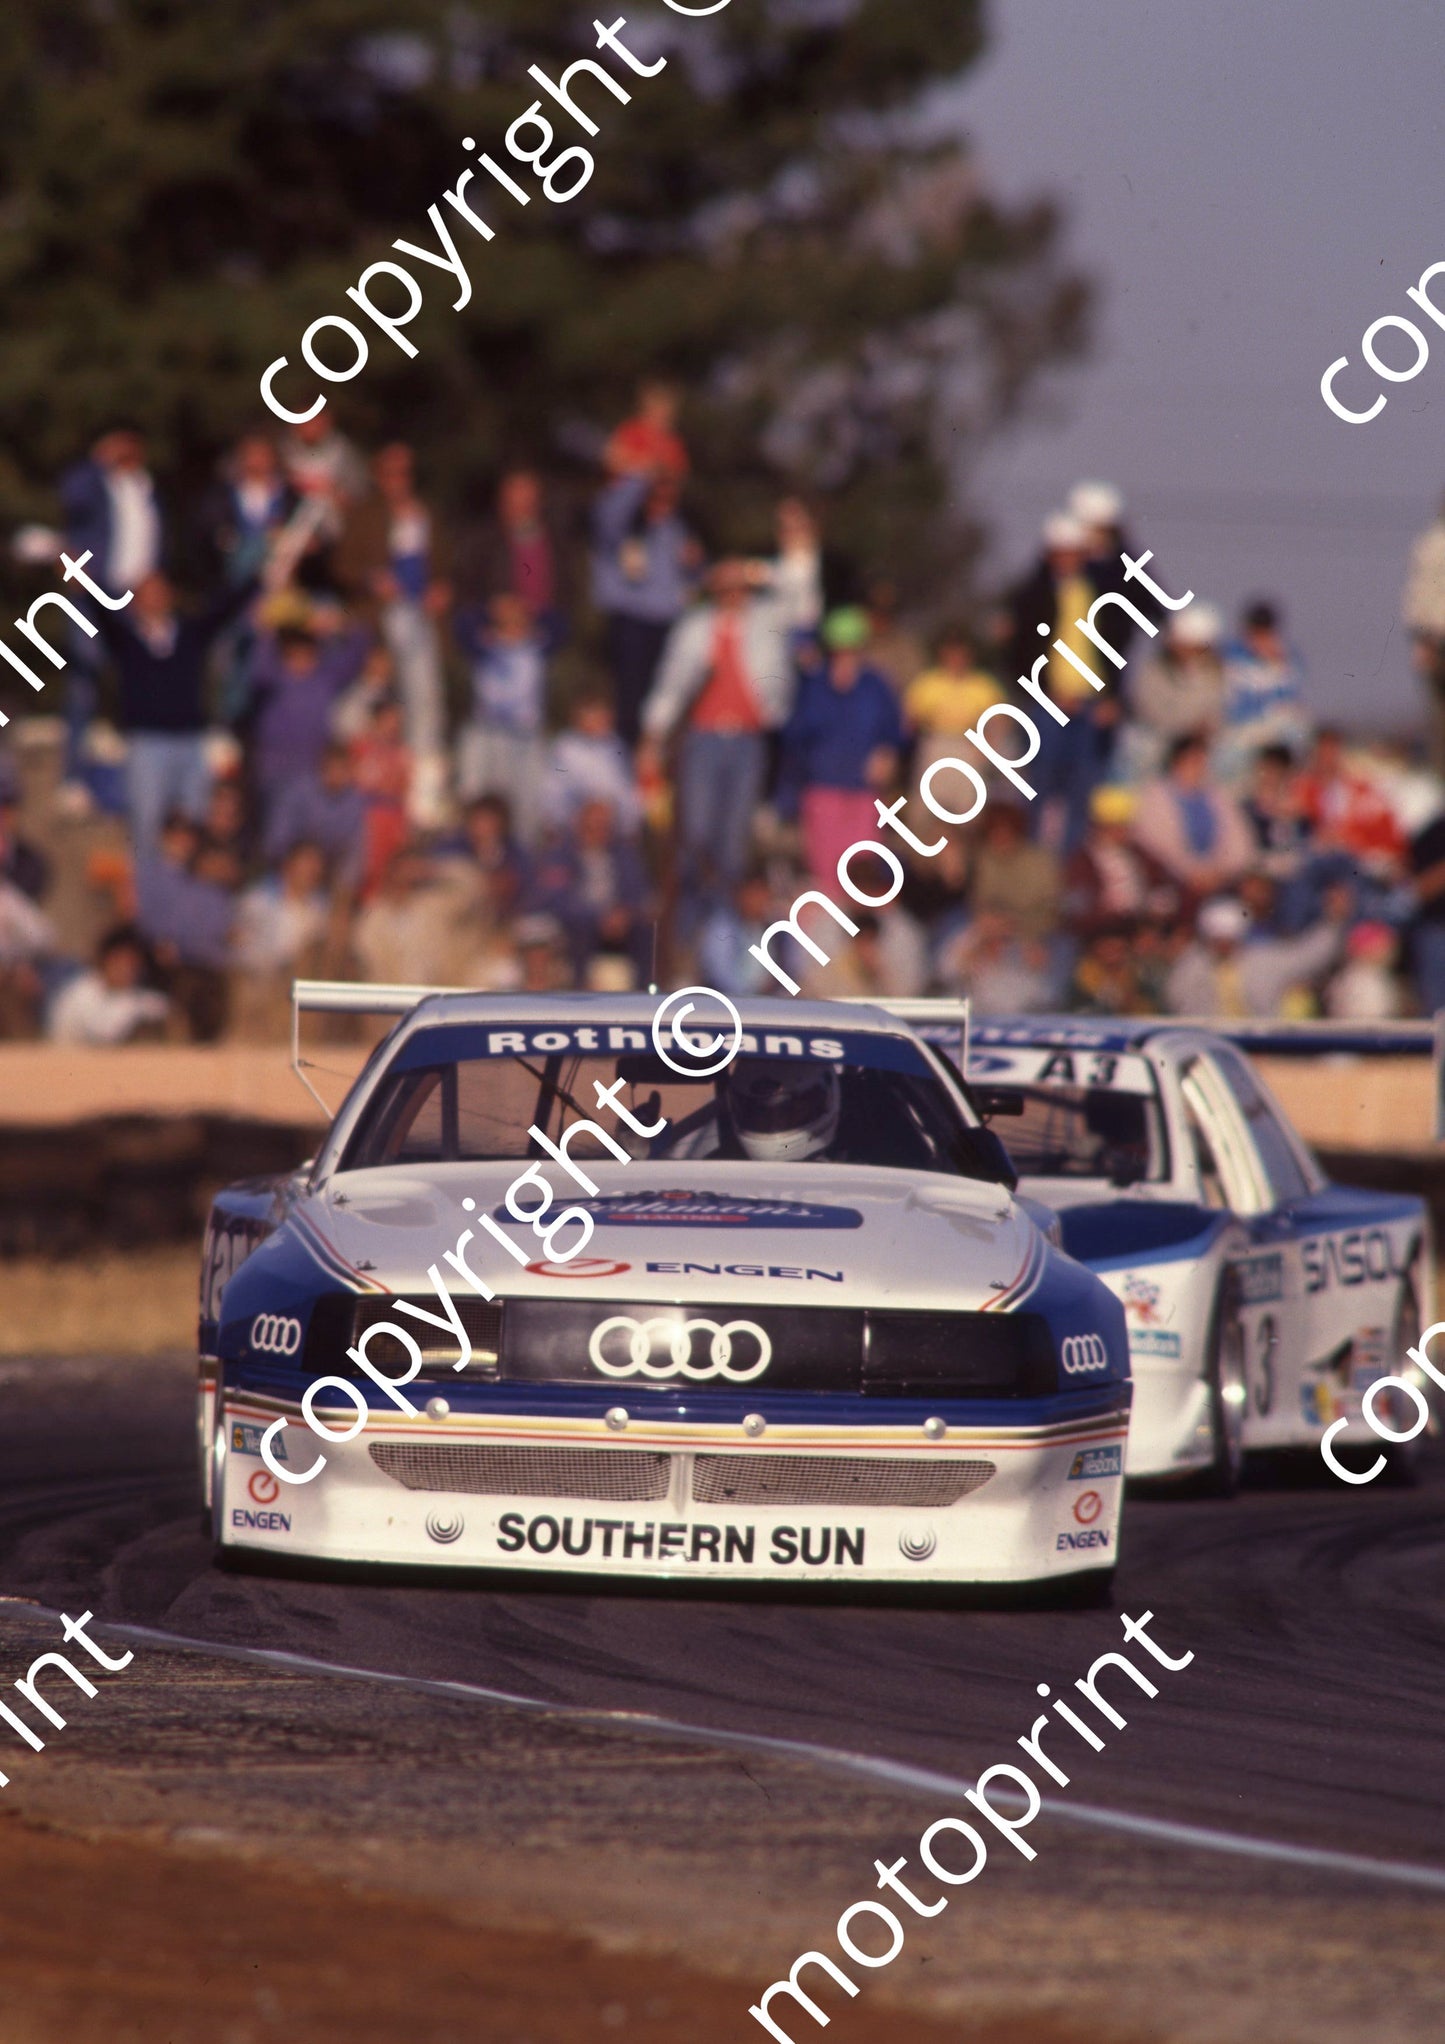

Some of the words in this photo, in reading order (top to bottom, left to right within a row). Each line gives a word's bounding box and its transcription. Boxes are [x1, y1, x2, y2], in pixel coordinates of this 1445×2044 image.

[488, 1027, 844, 1059] Rothmans
[645, 1262, 844, 1283] ENGEN
[232, 1509, 292, 1532] ENGEN
[496, 1512, 755, 1563] SOUTHERN
[769, 1525, 865, 1565] SUN
[1056, 1529, 1110, 1551] ENGEN
